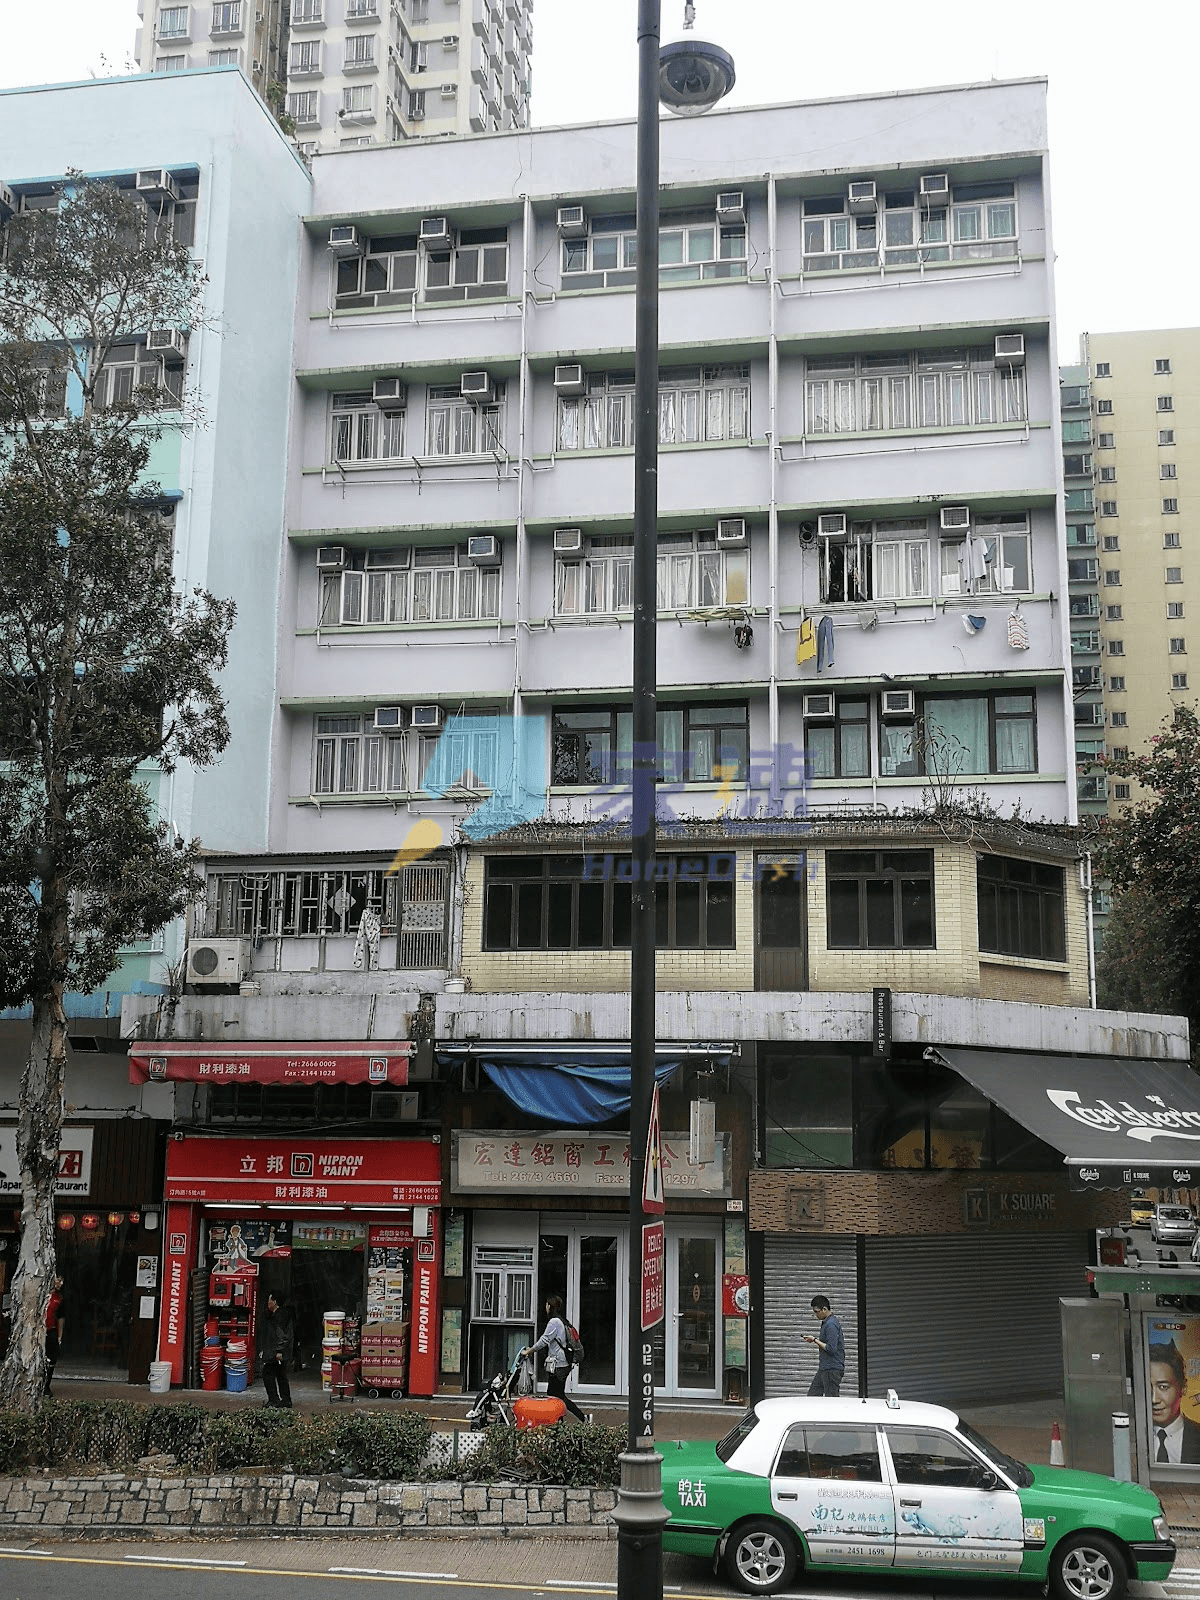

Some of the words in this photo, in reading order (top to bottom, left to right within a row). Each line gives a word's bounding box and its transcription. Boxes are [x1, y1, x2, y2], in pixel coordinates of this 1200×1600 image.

[199, 1063, 250, 1075] 財利漆油
[318, 1155, 363, 1166] NIPPON
[474, 1141, 706, 1171] 宏達鋁窗工公
[240, 1156, 284, 1173] 立邦
[323, 1166, 358, 1177] PAINT
[0, 1180, 22, 1191] Japa
[484, 1172, 507, 1183] Tel:
[511, 1172, 543, 1184] 2673
[547, 1172, 579, 1184] 4660
[596, 1173, 624, 1184] Fax:
[665, 1174, 698, 1186] 1297
[275, 1186, 328, 1198] 財利漆油
[1001, 1194, 1009, 1210] K
[1012, 1194, 1056, 1210] SQUARE
[171, 1261, 182, 1296] PAINT
[420, 1268, 430, 1304] PAINT
[168, 1298, 179, 1344] NIPPON
[418, 1306, 429, 1354] NIPPON
[643, 1373, 651, 1420] 0076
[643, 1425, 651, 1435] A
[678, 1479, 706, 1492] 的士
[678, 1493, 706, 1507] TAXI
[811, 1502, 844, 1520] 南記
[847, 1546, 863, 1555] 2451
[868, 1547, 884, 1556] 1698
